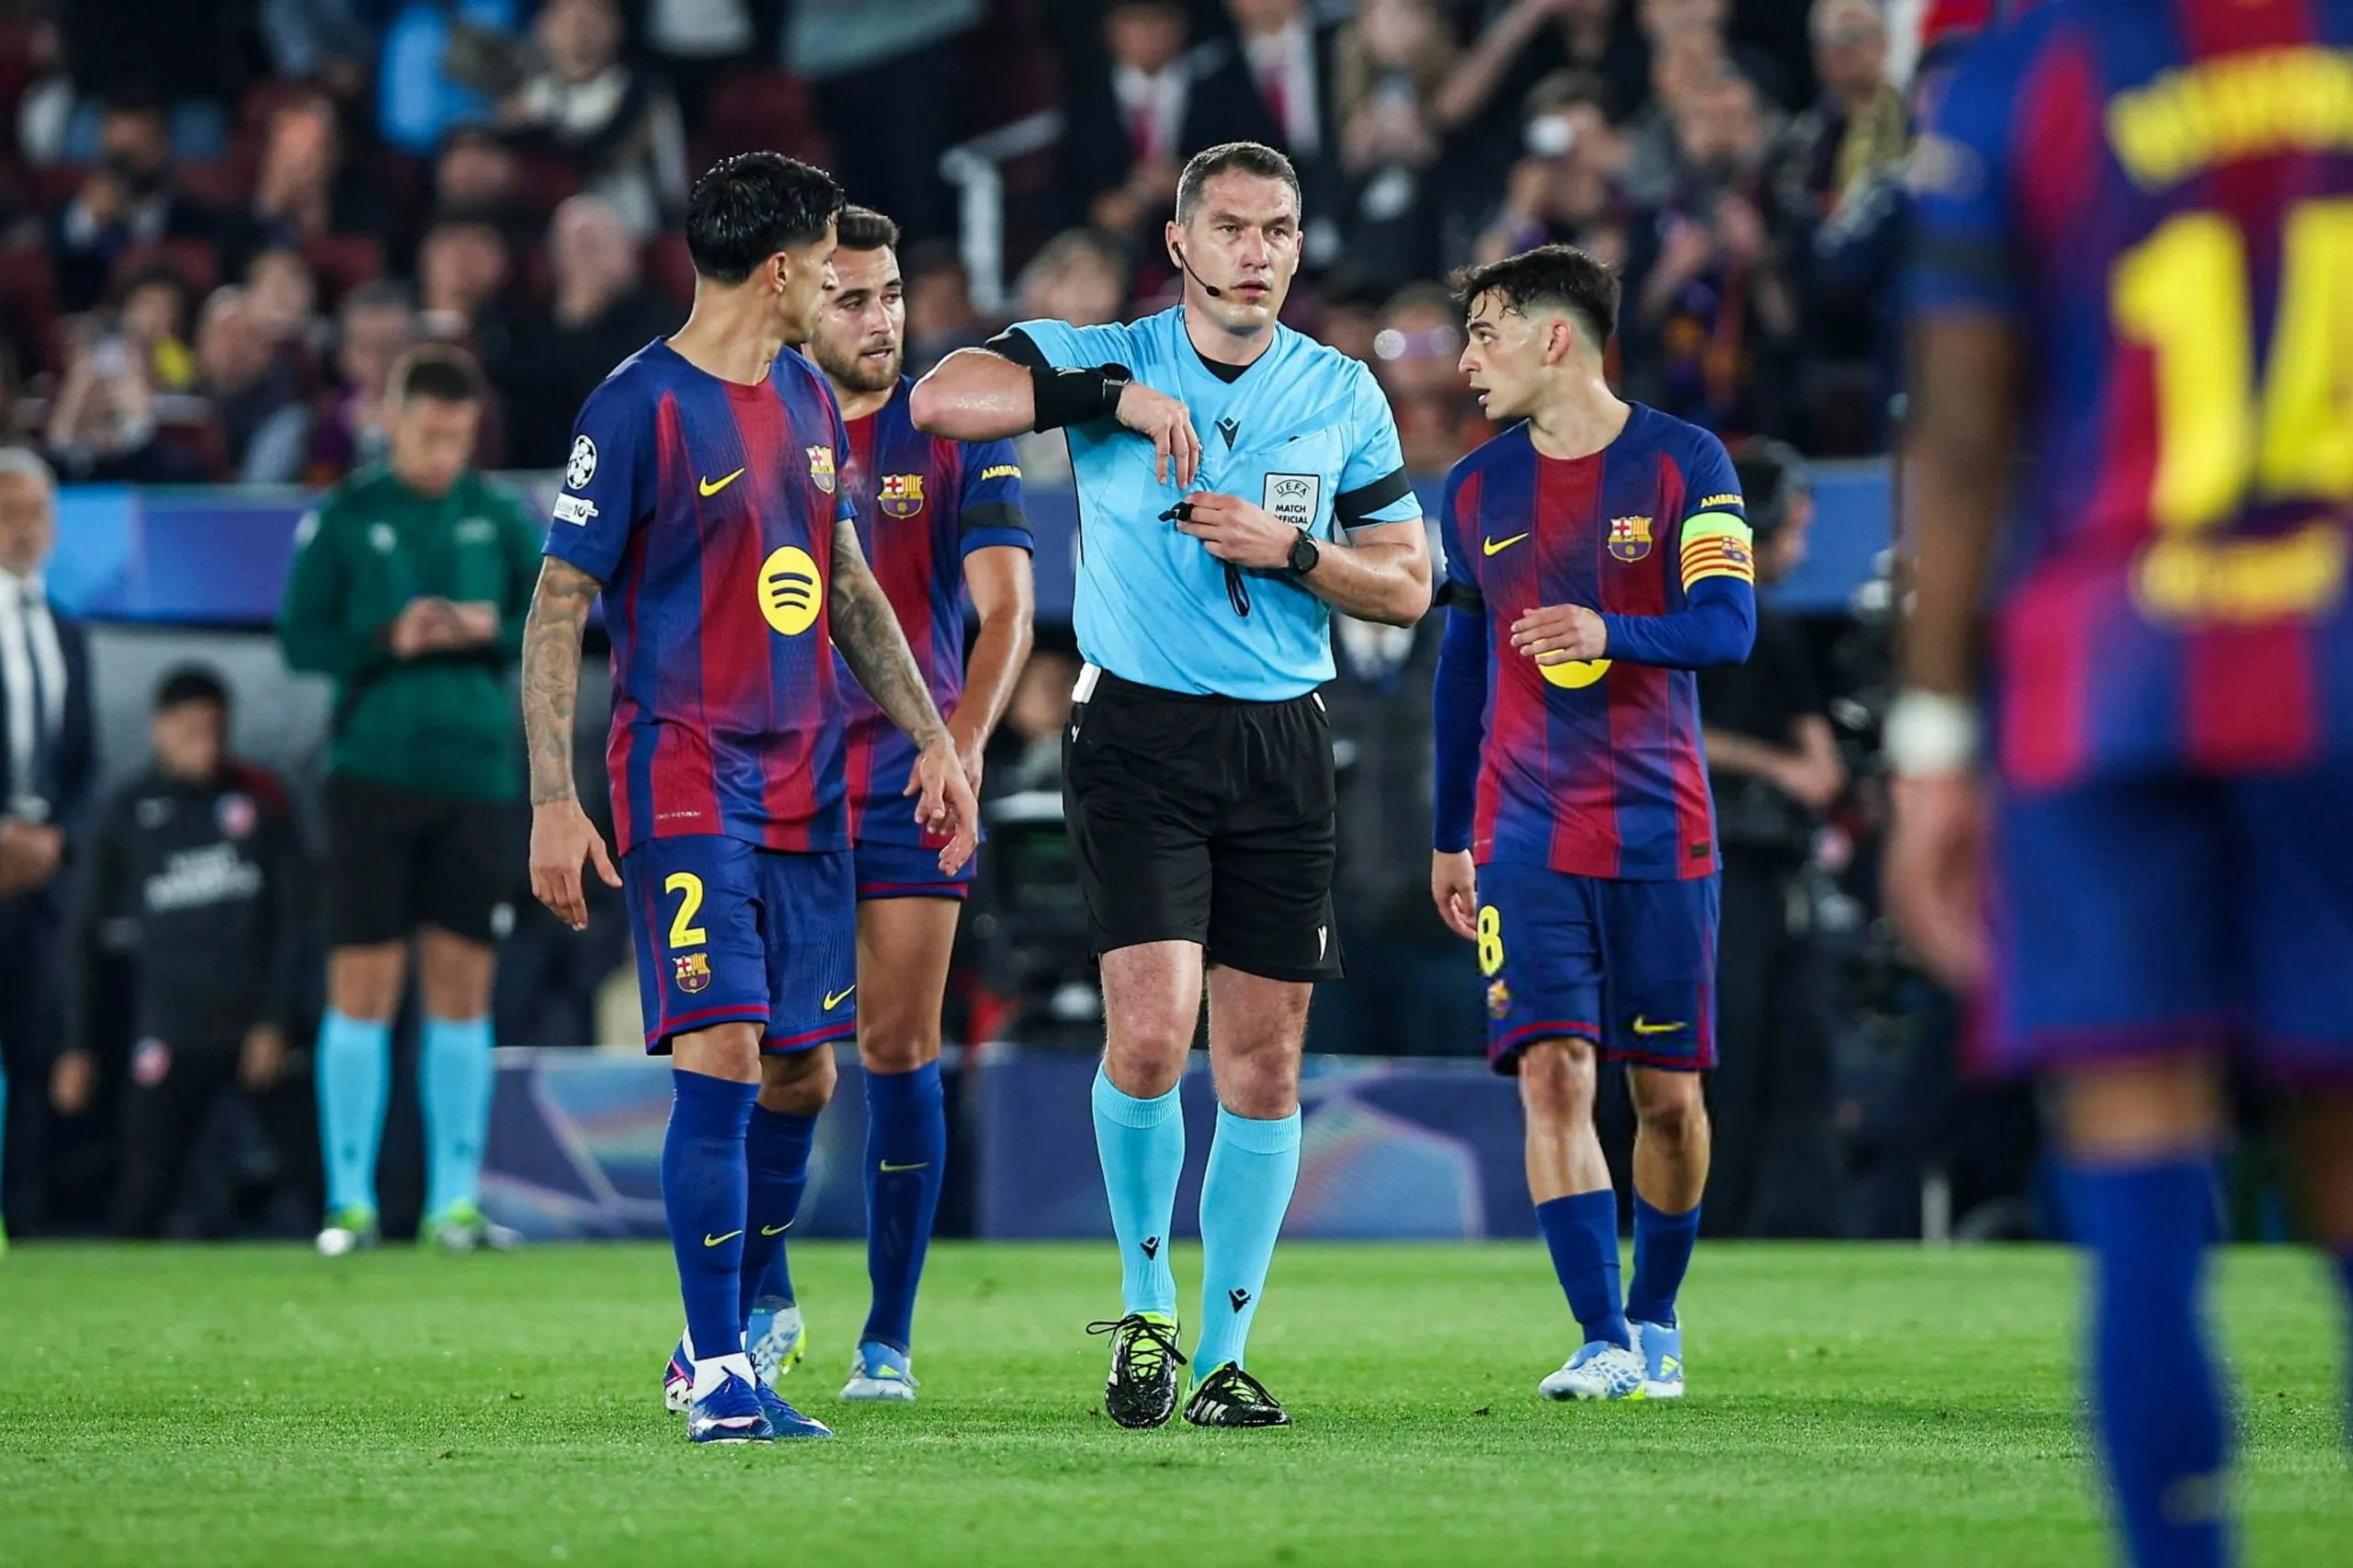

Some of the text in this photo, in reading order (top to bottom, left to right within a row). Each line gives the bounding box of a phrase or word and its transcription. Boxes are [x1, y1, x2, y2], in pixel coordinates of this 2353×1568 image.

[1276, 482, 1307, 496] UEFA
[1275, 503, 1306, 513] MATCH
[1274, 515, 1308, 524] FFICIAL
[665, 871, 708, 949] 2
[1477, 904, 1505, 976] 8
